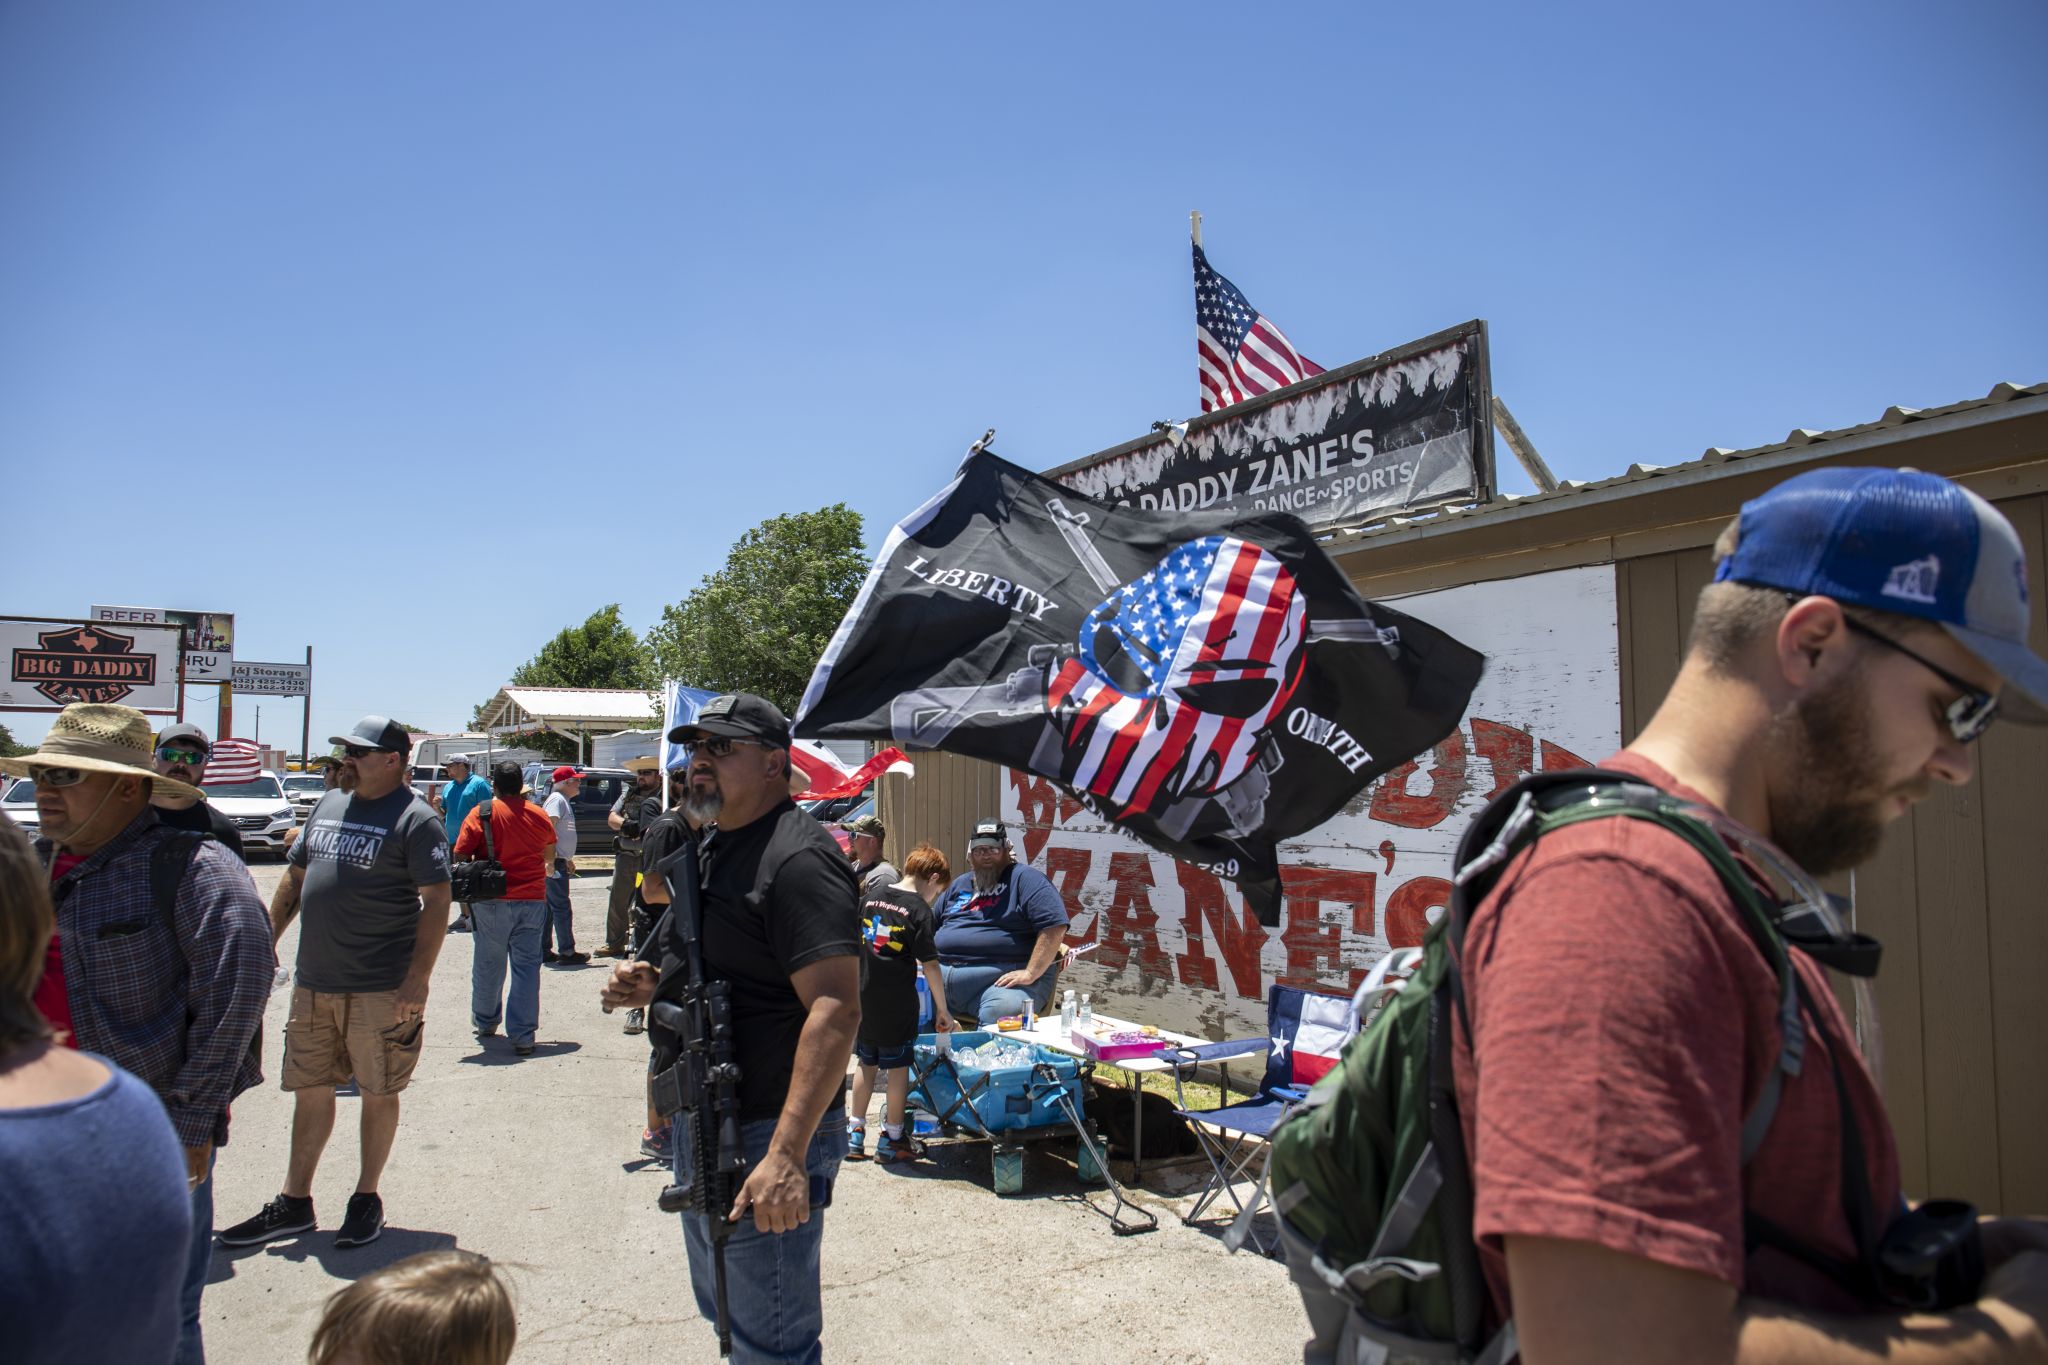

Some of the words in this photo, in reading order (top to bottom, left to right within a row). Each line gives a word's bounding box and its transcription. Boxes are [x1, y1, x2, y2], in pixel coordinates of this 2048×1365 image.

[1249, 429, 1374, 495] ZANE'S
[904, 555, 1059, 621] LIBERTY
[100, 610, 156, 623] BEER
[22, 658, 61, 674] BIG
[72, 660, 147, 677] DADDY
[185, 655, 217, 667] HRU
[253, 668, 302, 678] Storage
[310, 830, 376, 860] AMERICA
